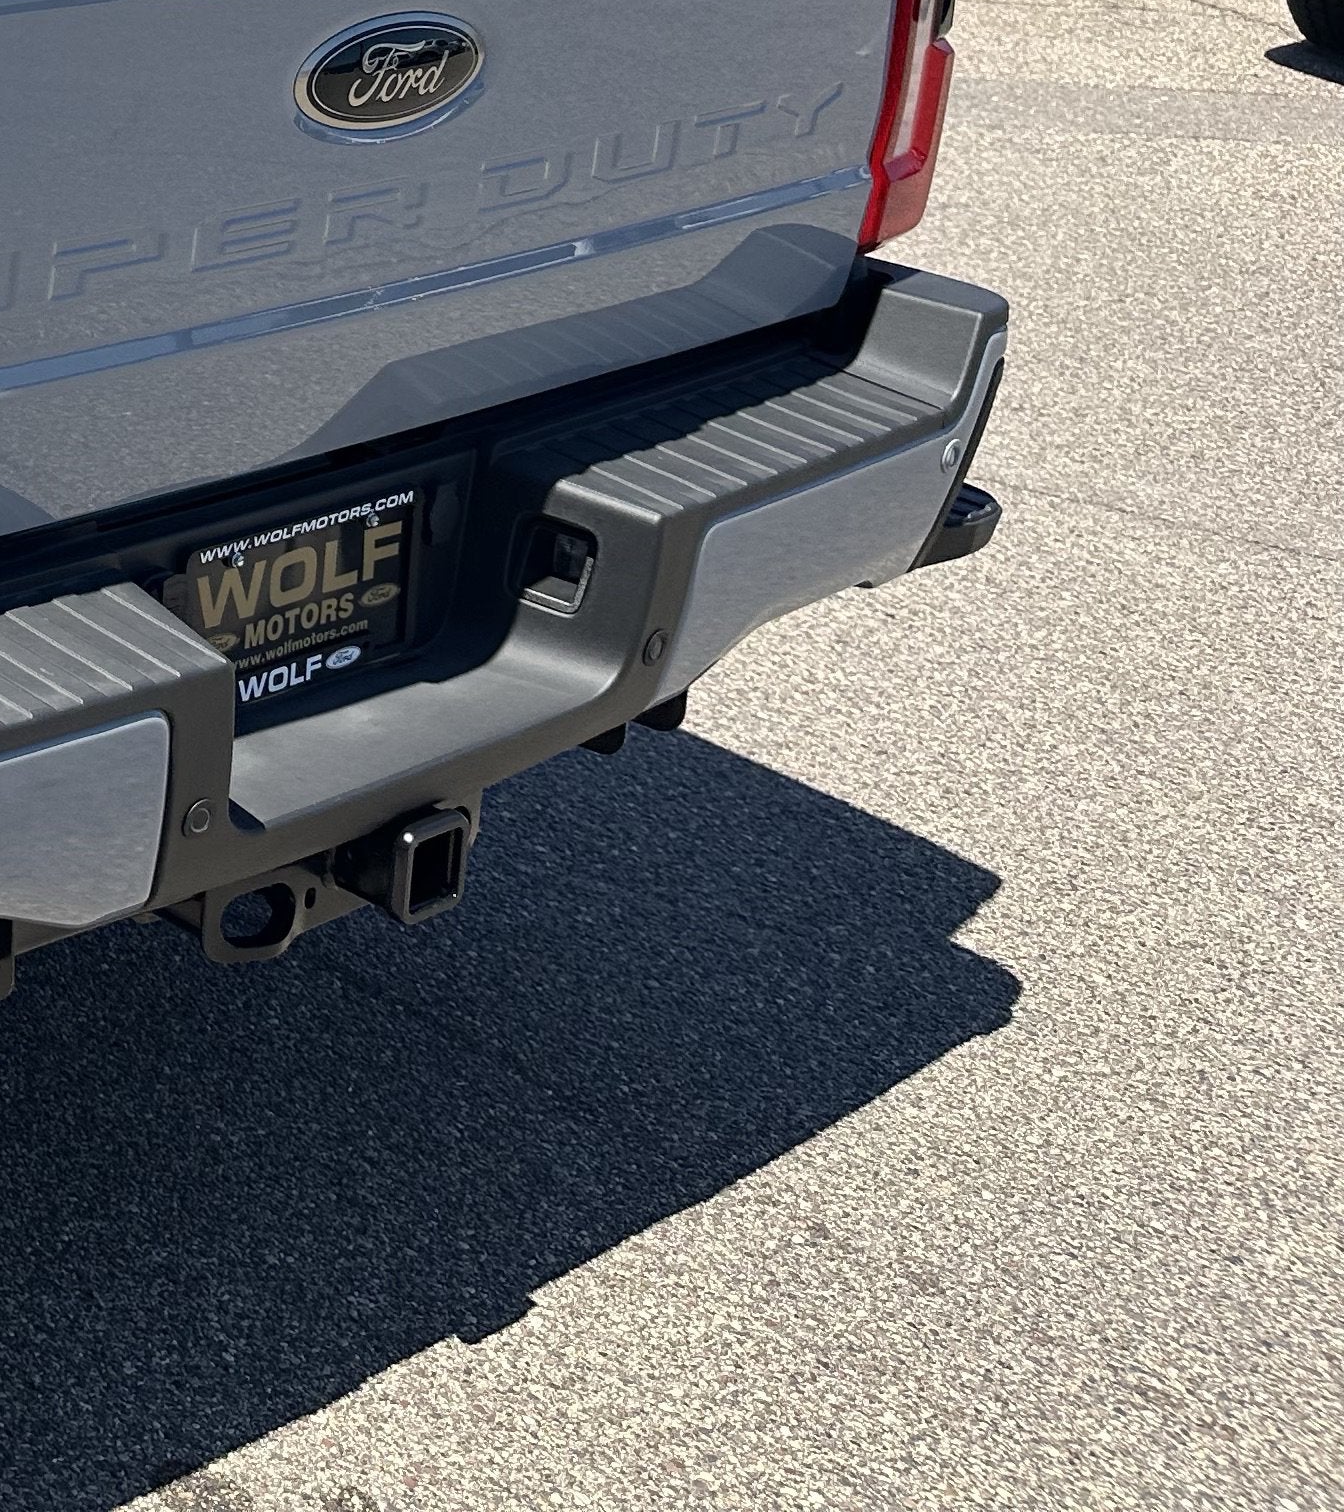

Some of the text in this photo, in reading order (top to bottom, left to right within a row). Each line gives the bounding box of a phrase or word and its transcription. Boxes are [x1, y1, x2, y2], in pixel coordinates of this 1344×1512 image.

[347, 39, 450, 108] Ford
[478, 81, 845, 215] DUTY
[200, 490, 414, 564] WWW.WOLFMOTORS.COM
[196, 520, 403, 629] WOLF
[234, 619, 369, 670] ww.wolfmotors.com
[244, 592, 355, 649] MOTORS
[237, 653, 323, 702] WOLF
